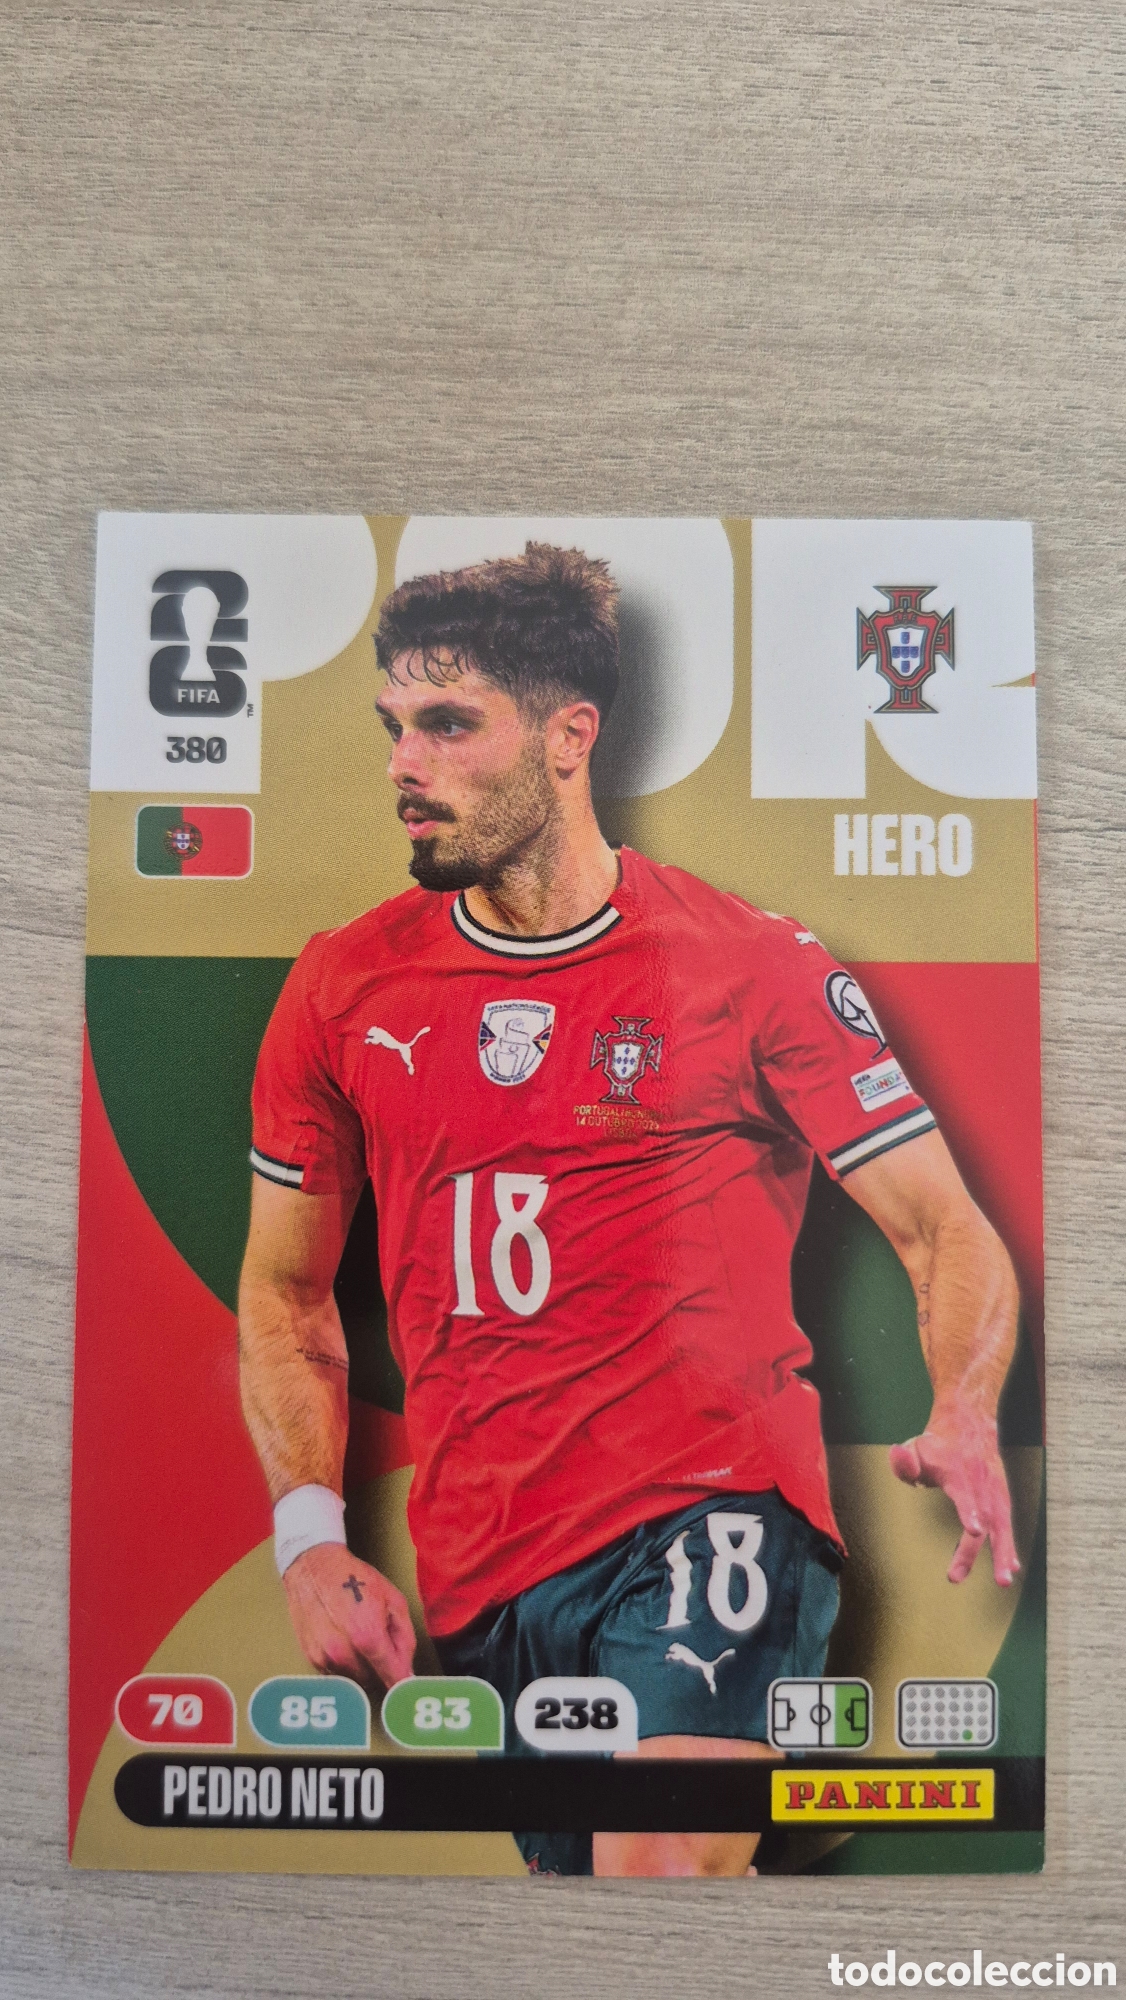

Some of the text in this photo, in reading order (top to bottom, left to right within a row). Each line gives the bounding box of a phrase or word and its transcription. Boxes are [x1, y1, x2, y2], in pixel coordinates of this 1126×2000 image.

[177, 688, 221, 704] FIFA
[166, 736, 228, 764] 380
[833, 812, 974, 878] HERO
[445, 1171, 552, 1317] 18
[656, 1511, 768, 1632] 18
[148, 1692, 204, 1727] 70
[279, 1694, 339, 1729] 85
[413, 1694, 472, 1730] 83
[534, 1696, 620, 1731] 238
[163, 1764, 384, 1819] PEDRO NETO
[785, 1780, 981, 1810] PANINI
